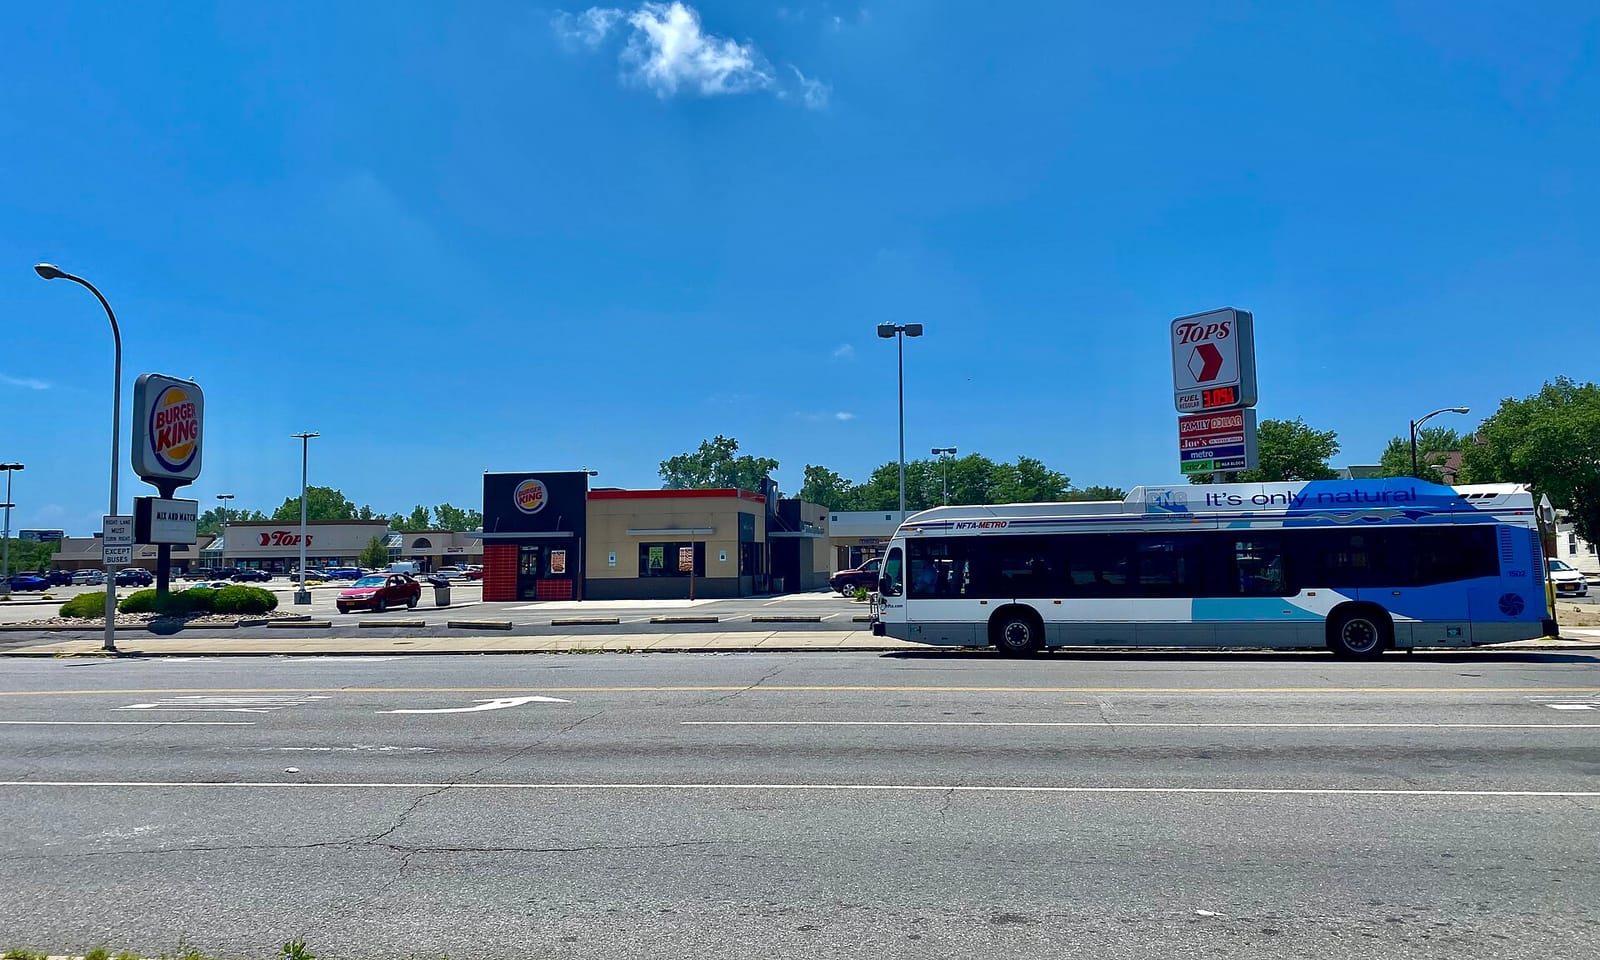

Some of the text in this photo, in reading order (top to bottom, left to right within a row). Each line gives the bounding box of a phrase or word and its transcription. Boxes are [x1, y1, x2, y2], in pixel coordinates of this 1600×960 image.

[1180, 394, 1200, 402] FUEL
[156, 403, 195, 429] BURGER
[1181, 415, 1242, 432] FAMILY DOLLAR
[157, 419, 198, 453] KING
[1182, 438, 1207, 448] Joe's
[1190, 450, 1214, 459] metro
[518, 486, 542, 497] BURGER
[1206, 487, 1416, 507] It's only natural
[519, 492, 542, 504] KING
[167, 512, 179, 521] AND
[180, 513, 196, 521] MATCH
[955, 521, 1008, 529] NFTA-METRO
